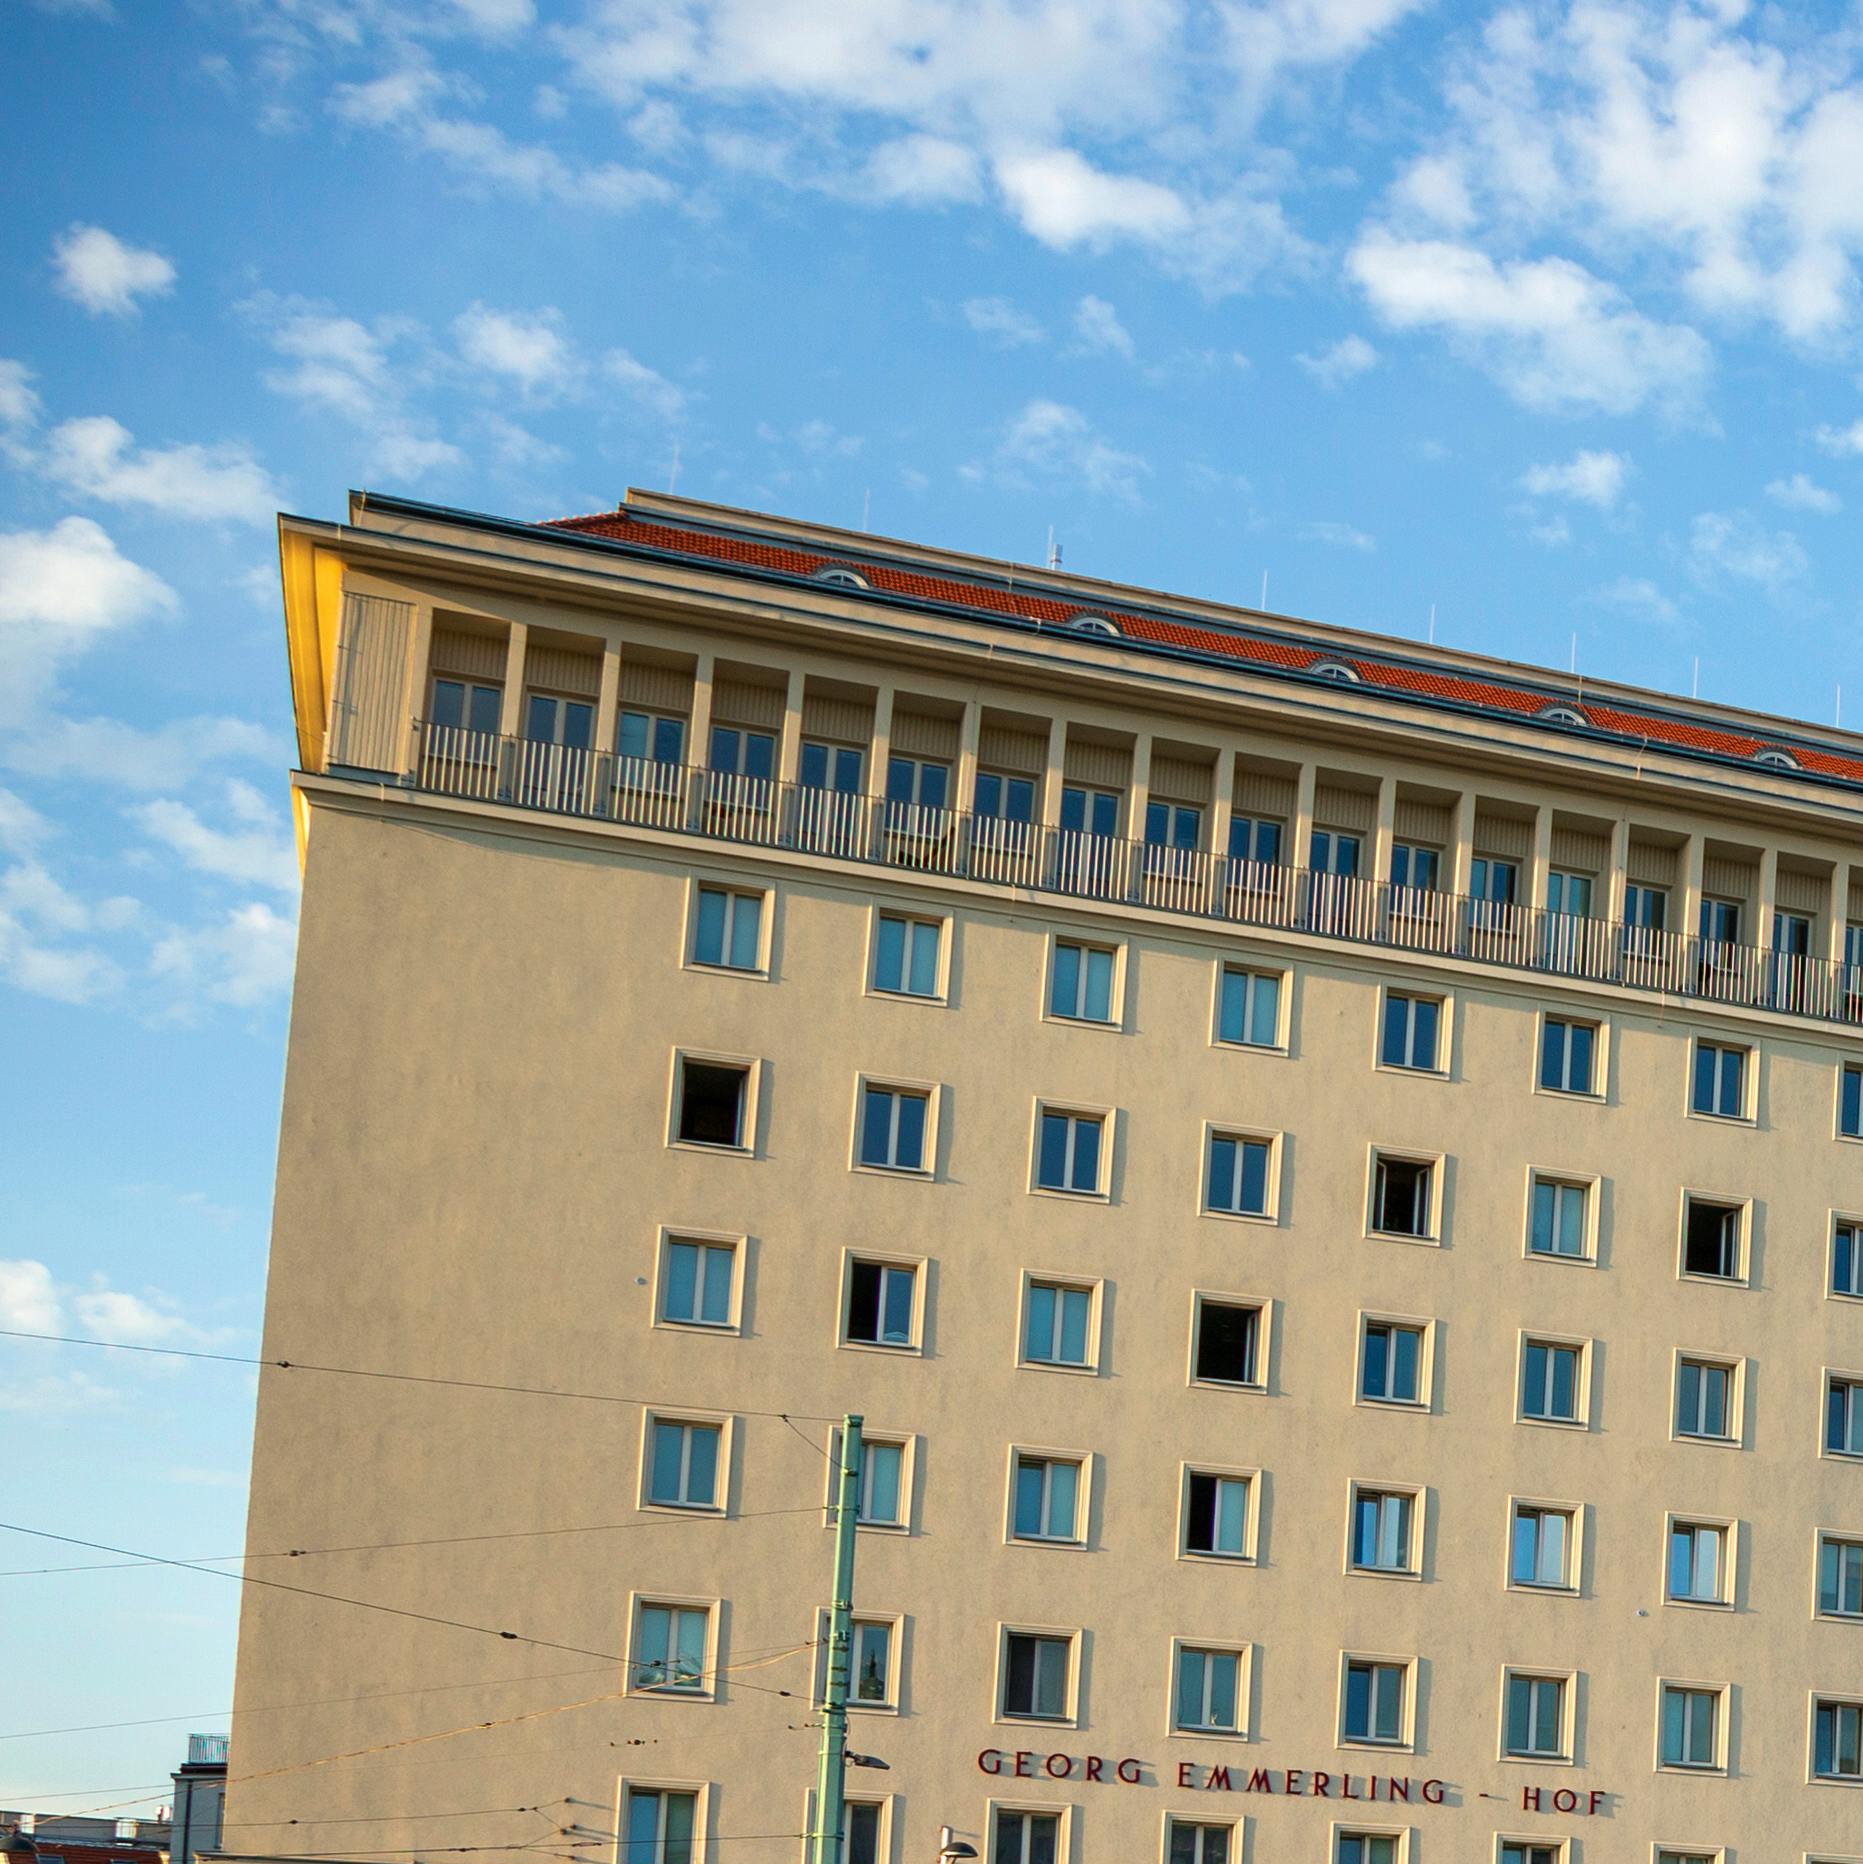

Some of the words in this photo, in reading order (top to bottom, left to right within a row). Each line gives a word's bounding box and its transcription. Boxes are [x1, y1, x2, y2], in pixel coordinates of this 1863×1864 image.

[978, 1749, 1141, 1784] GEORG
[1177, 1762, 1444, 1804] EMMERLING
[1522, 1786, 1606, 1815] HOF
